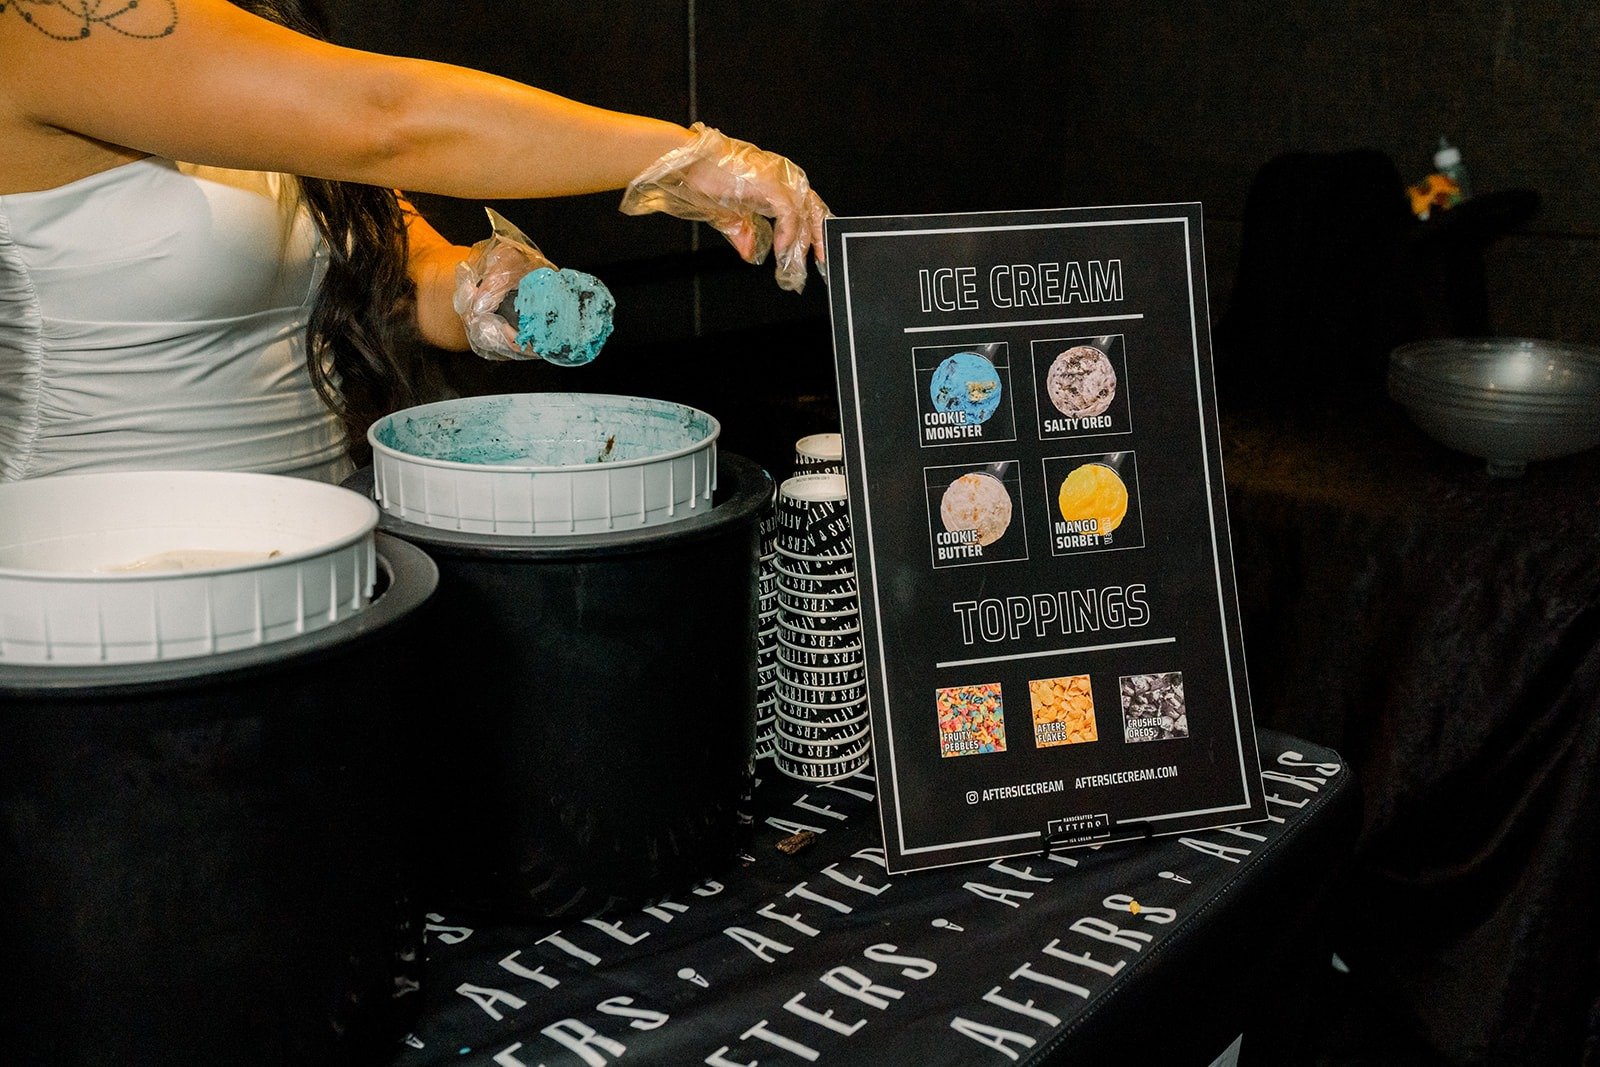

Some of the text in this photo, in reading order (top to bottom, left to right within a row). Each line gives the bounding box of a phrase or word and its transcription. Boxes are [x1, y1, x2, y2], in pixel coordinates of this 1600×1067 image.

[918, 259, 1124, 313] ICE CREAM
[924, 411, 967, 426] COOKIE
[1044, 415, 1112, 433] SALTY OREO
[925, 425, 983, 441] MONSTER
[1055, 519, 1098, 535] MANGO
[936, 529, 978, 545] COOKIE
[1056, 534, 1100, 549] SORBET
[937, 545, 983, 560] BUTTER
[953, 584, 1150, 645] TOPPINGS
[1037, 722, 1066, 734] AFTERS
[1127, 717, 1162, 729] CRUSHED
[943, 731, 971, 742] FRUITY
[1038, 731, 1067, 742] FLAKES
[1128, 728, 1154, 738] OREOS
[944, 741, 979, 752] PEBBLES
[802, 762, 847, 777] AFTERS
[982, 765, 1178, 801] AFTERSICECREAM AFTERSICECREAM.COM
[950, 751, 1341, 1061] AFTERS AFERS
